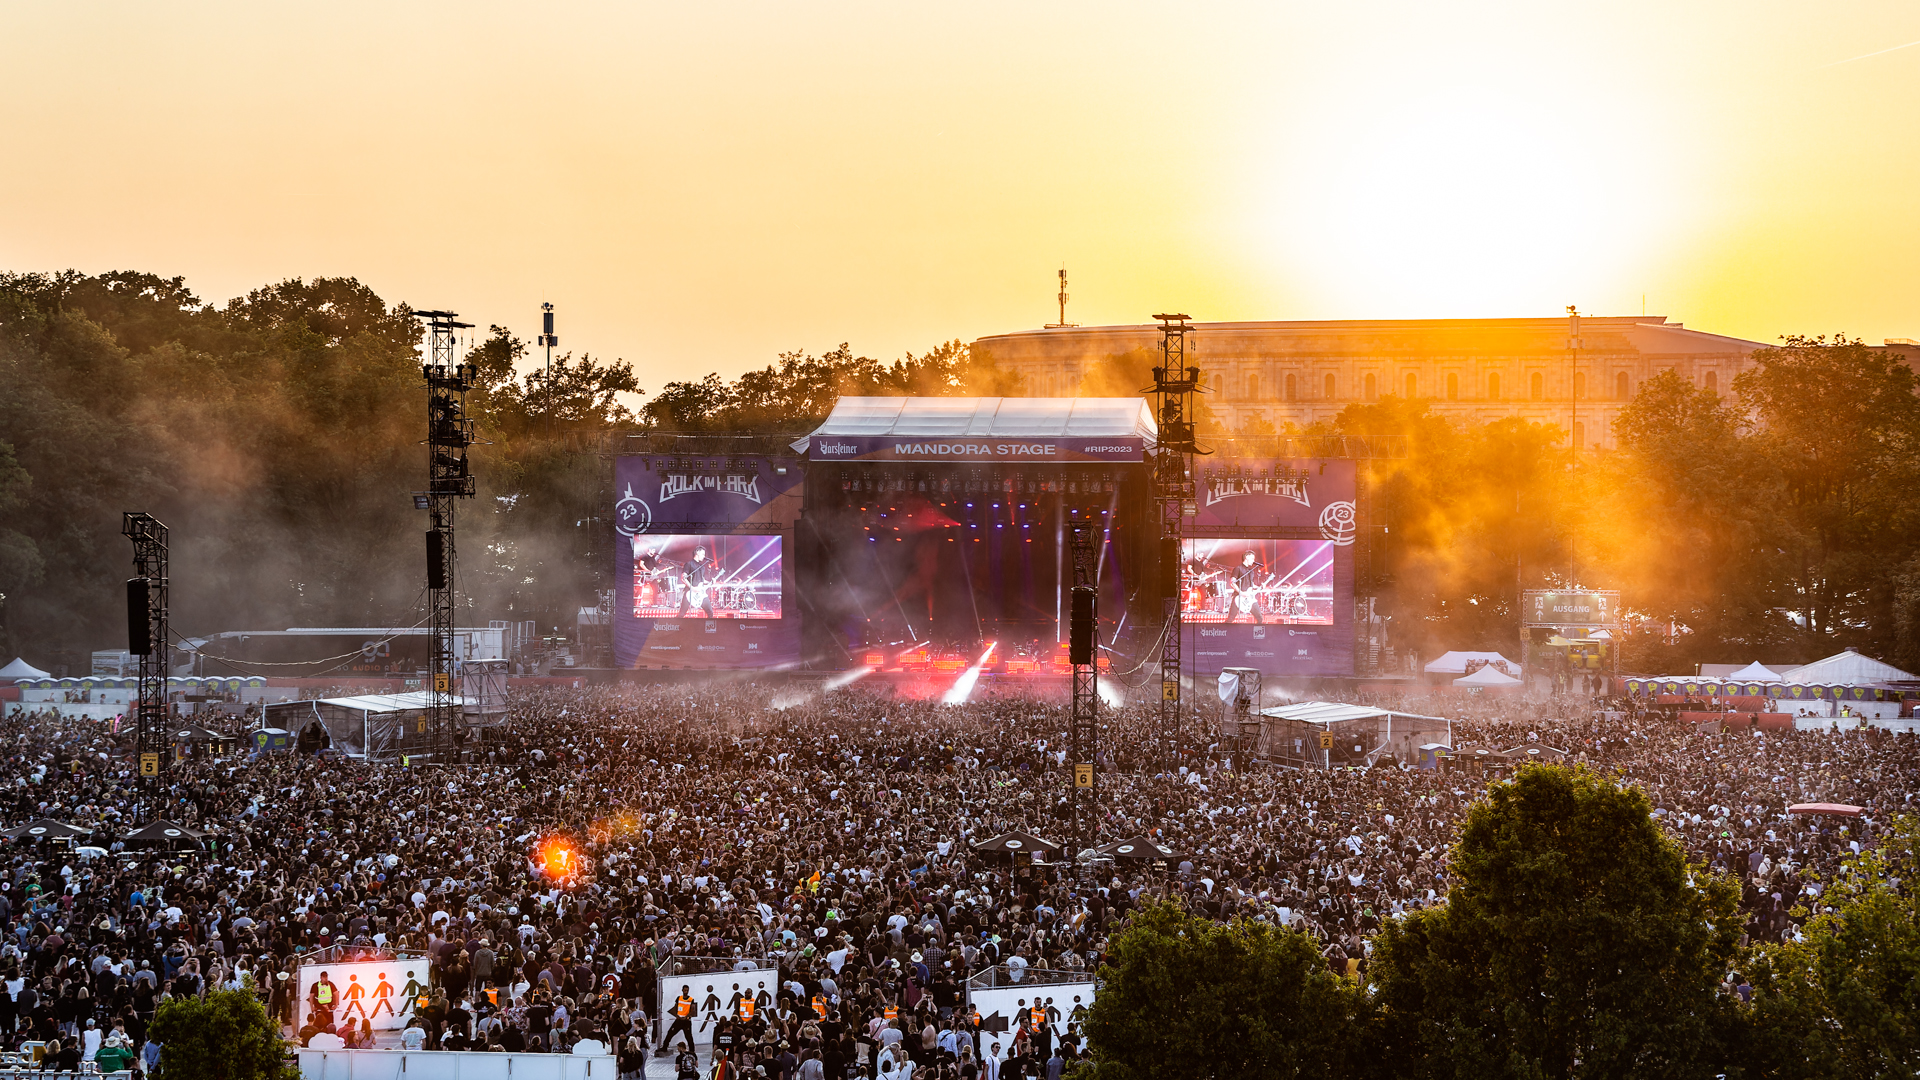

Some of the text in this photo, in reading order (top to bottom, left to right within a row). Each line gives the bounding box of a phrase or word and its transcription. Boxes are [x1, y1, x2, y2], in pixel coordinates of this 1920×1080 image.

[895, 443, 1056, 455] MANDORA STAGE
[1085, 445, 1133, 453] #RIP2023
[619, 503, 638, 521] 23
[1336, 509, 1349, 519] 23
[1553, 605, 1590, 613] AUSGANG
[438, 681, 445, 689] 3
[1166, 689, 1174, 697] 4
[1323, 738, 1330, 746] 2
[145, 762, 153, 772] 5
[1080, 774, 1087, 784] 6
